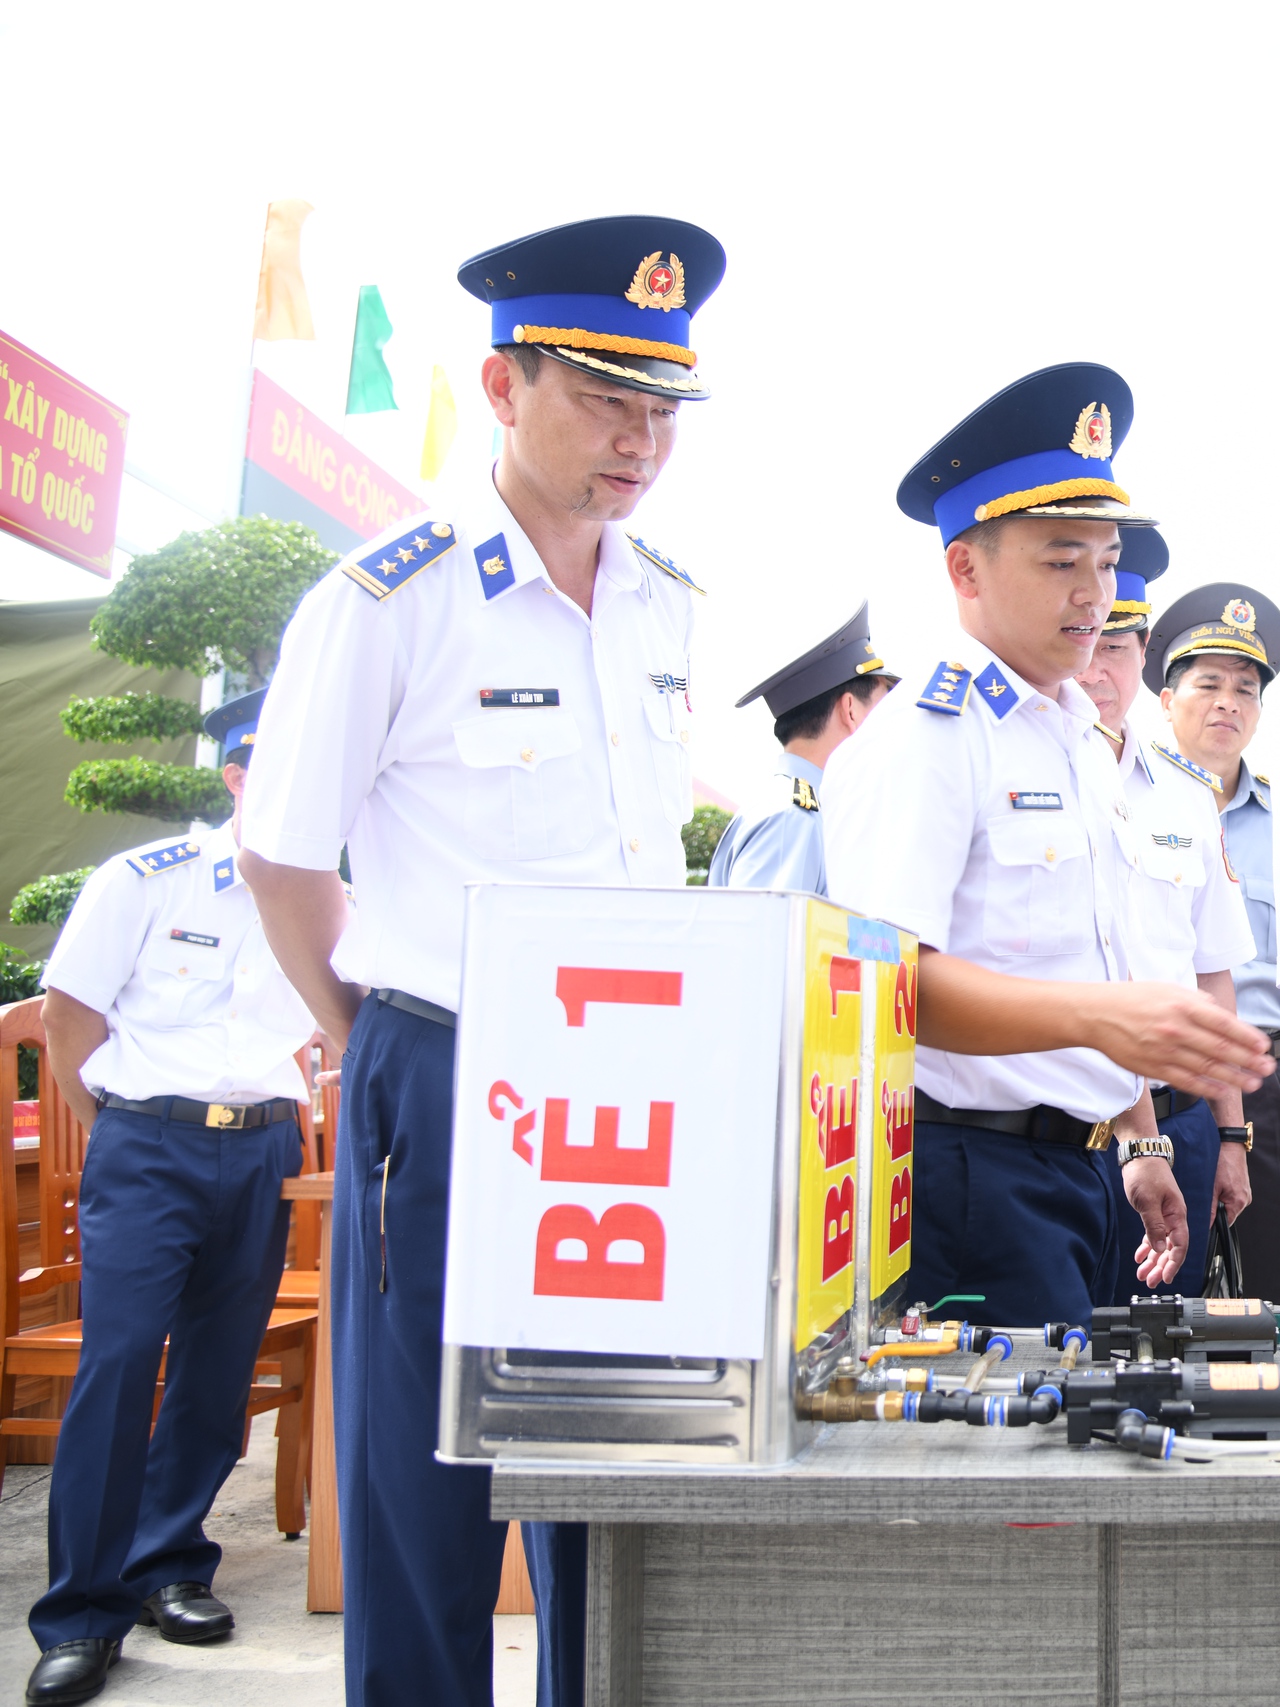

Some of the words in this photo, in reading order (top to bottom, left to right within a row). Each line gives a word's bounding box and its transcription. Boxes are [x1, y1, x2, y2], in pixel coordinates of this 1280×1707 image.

[52, 406, 109, 476] DỰNG
[271, 406, 337, 493] ĐẢNG
[340, 462, 399, 528] CỘNG
[10, 446, 41, 505] TỔ
[41, 474, 96, 535] QUỐC
[1190, 625, 1213, 640] KIỂM
[1215, 626, 1236, 636] NGƯ
[555, 965, 684, 1028] 1
[828, 954, 863, 1018] 1
[894, 959, 917, 1038] 2
[487, 1079, 675, 1302] BỂ
[810, 1072, 859, 1286] BỂ
[881, 1078, 914, 1258] BỂ
